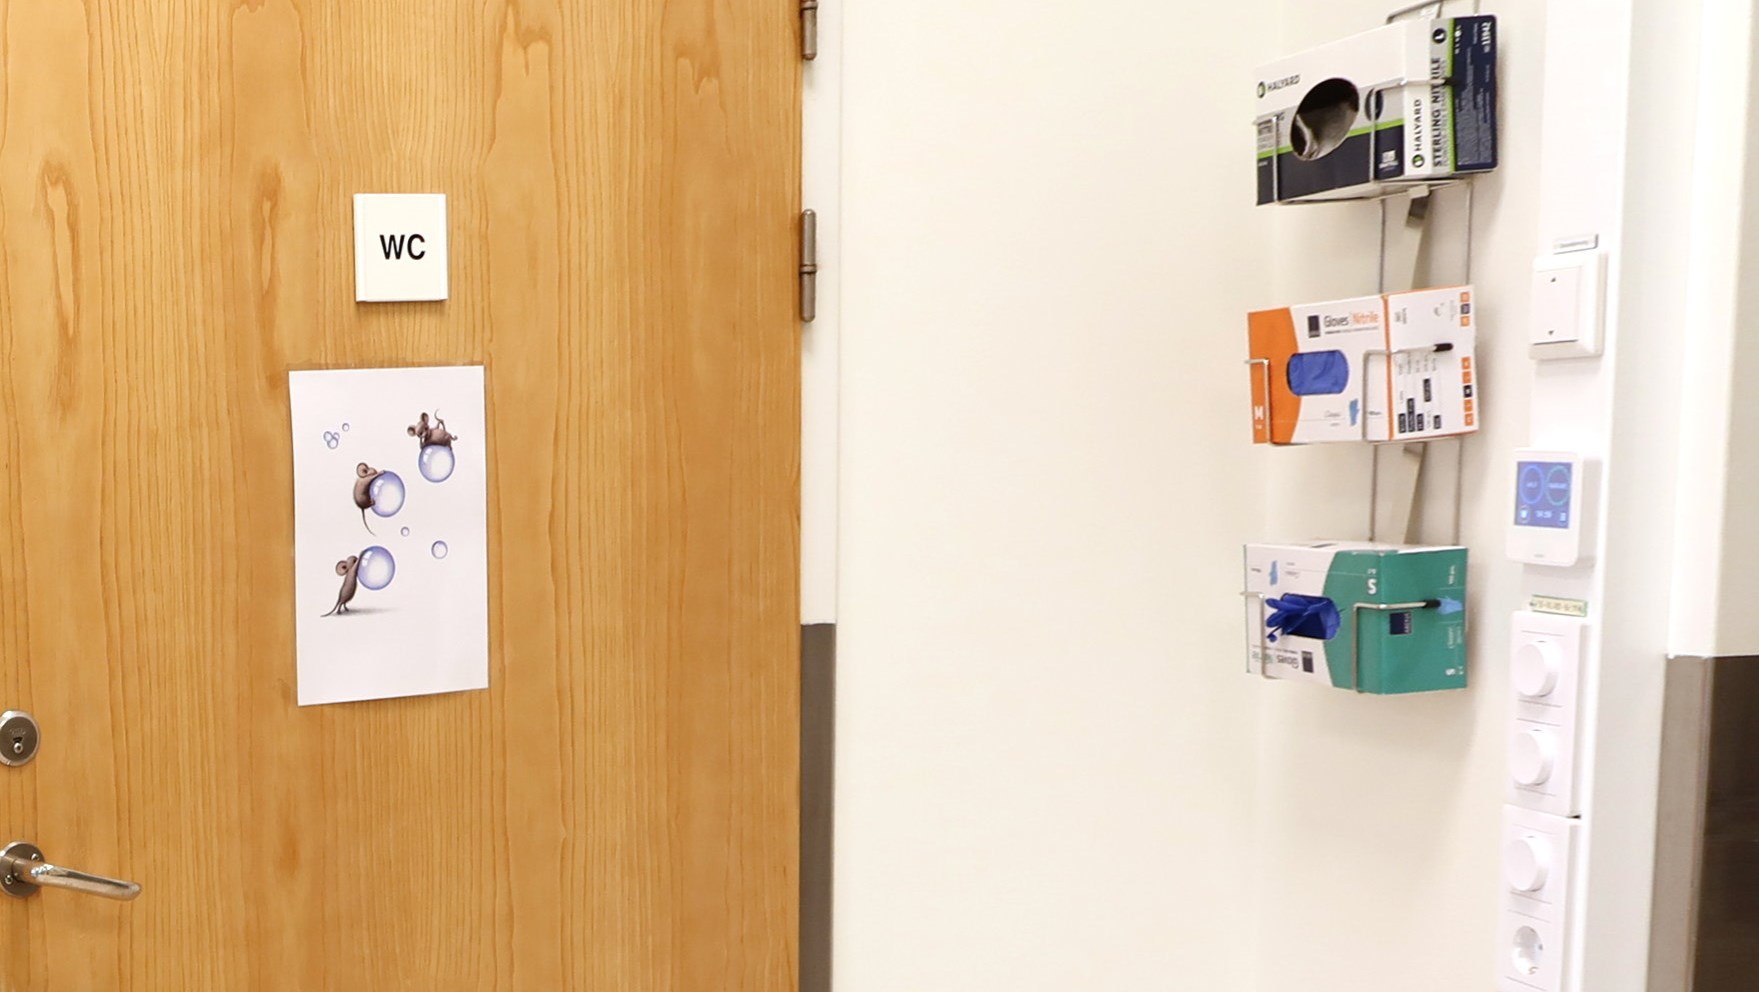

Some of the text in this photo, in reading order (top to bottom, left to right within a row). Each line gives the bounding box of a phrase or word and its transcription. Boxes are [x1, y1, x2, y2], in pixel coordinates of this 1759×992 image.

[1267, 74, 1301, 91] HALYARD
[1413, 99, 1422, 151] HALYARD
[1431, 109, 1441, 167] STERLING
[379, 233, 426, 260] WC
[1323, 315, 1349, 328] Gloves
[1254, 405, 1264, 420] M
[1367, 578, 1377, 594] S
